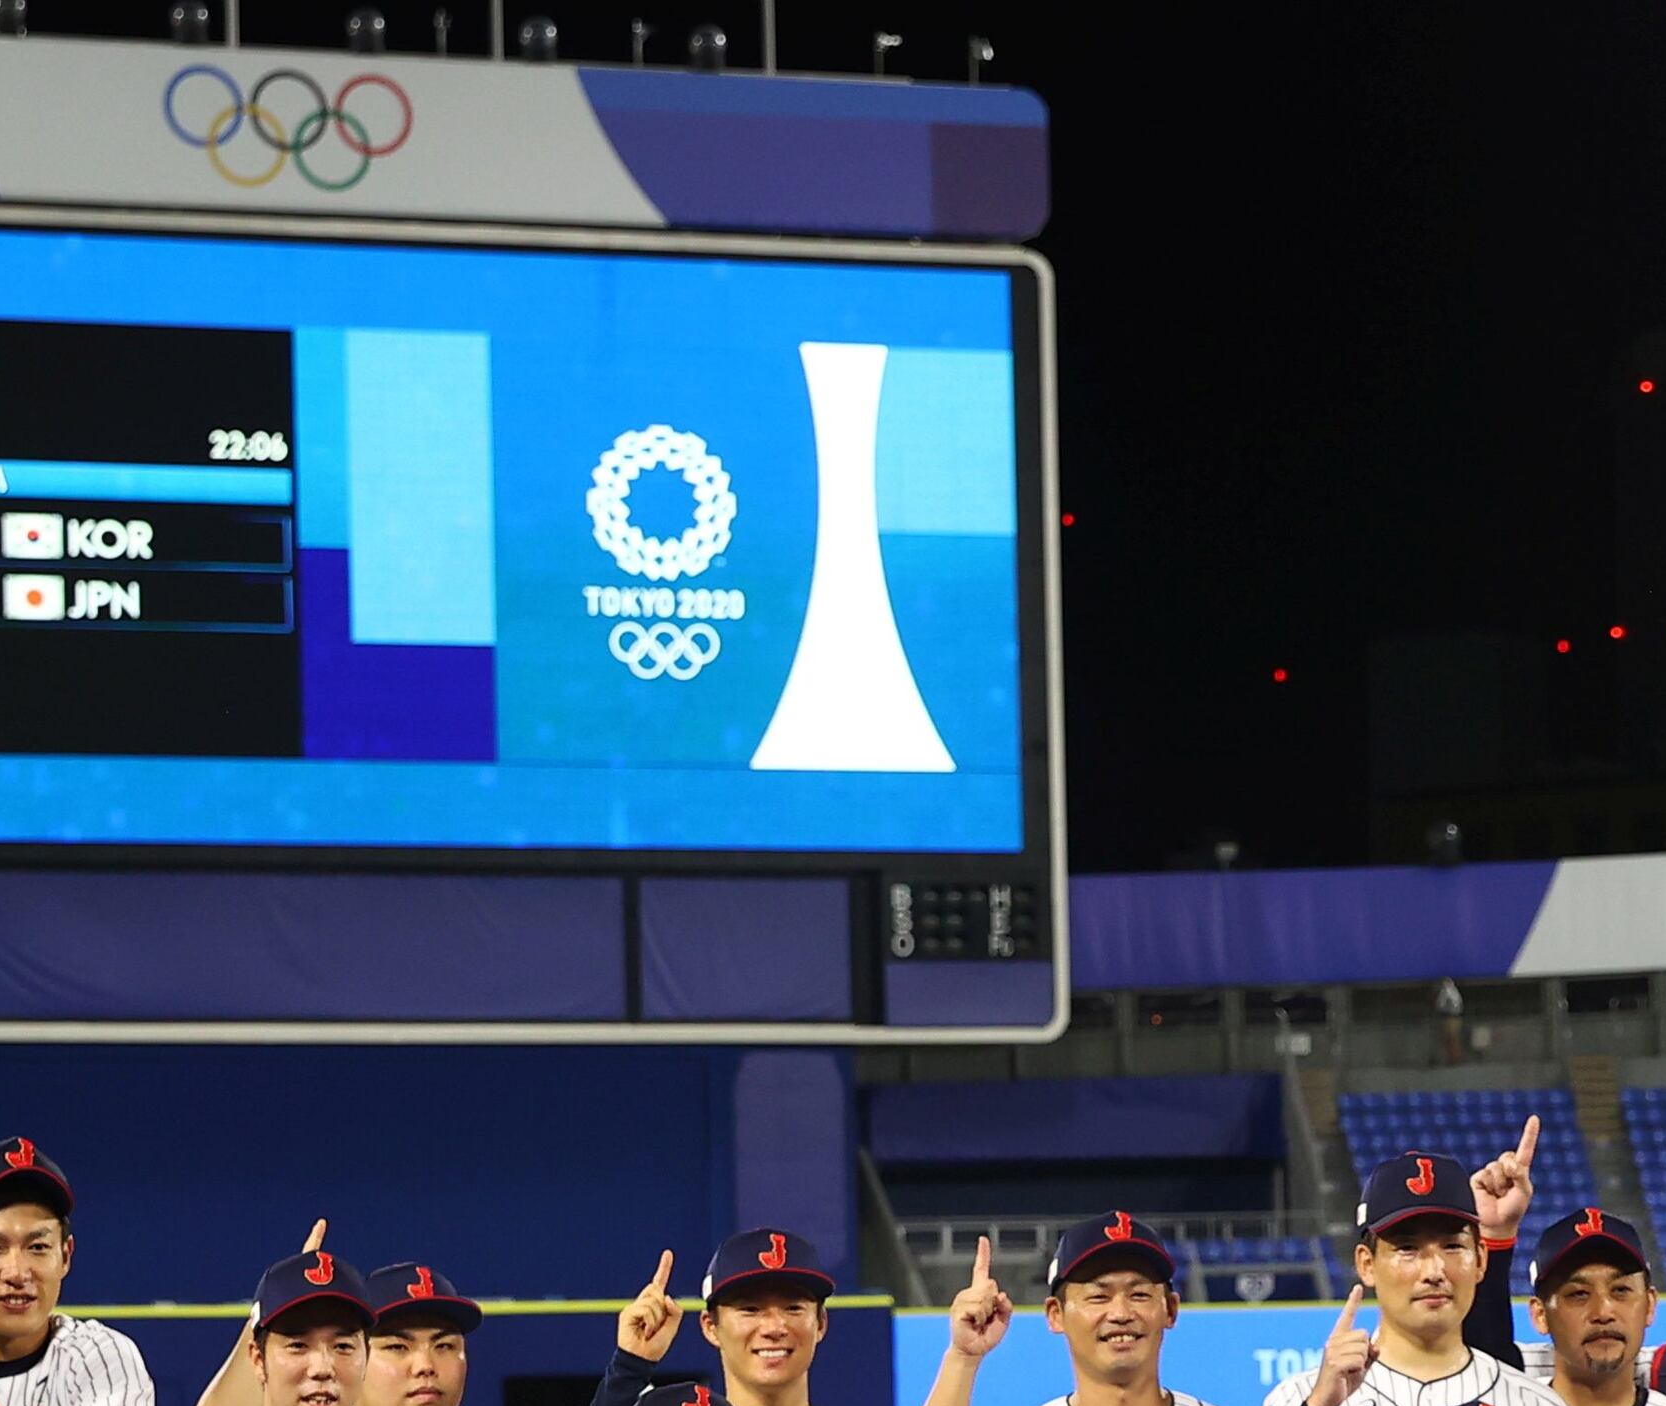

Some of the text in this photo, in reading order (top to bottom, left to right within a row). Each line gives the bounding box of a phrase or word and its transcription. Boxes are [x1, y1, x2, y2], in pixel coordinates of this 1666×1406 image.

[209, 429, 289, 462] 22:06
[67, 518, 154, 560] KOR
[66, 580, 141, 620] JPN
[582, 585, 746, 620] TOKYO 2020
[5, 1138, 35, 1170] J
[1406, 1158, 1435, 1195] J
[1104, 1211, 1133, 1242] J
[1574, 1207, 1604, 1238] J
[304, 1250, 334, 1285] J
[758, 1233, 787, 1271] J
[407, 1266, 440, 1300] J
